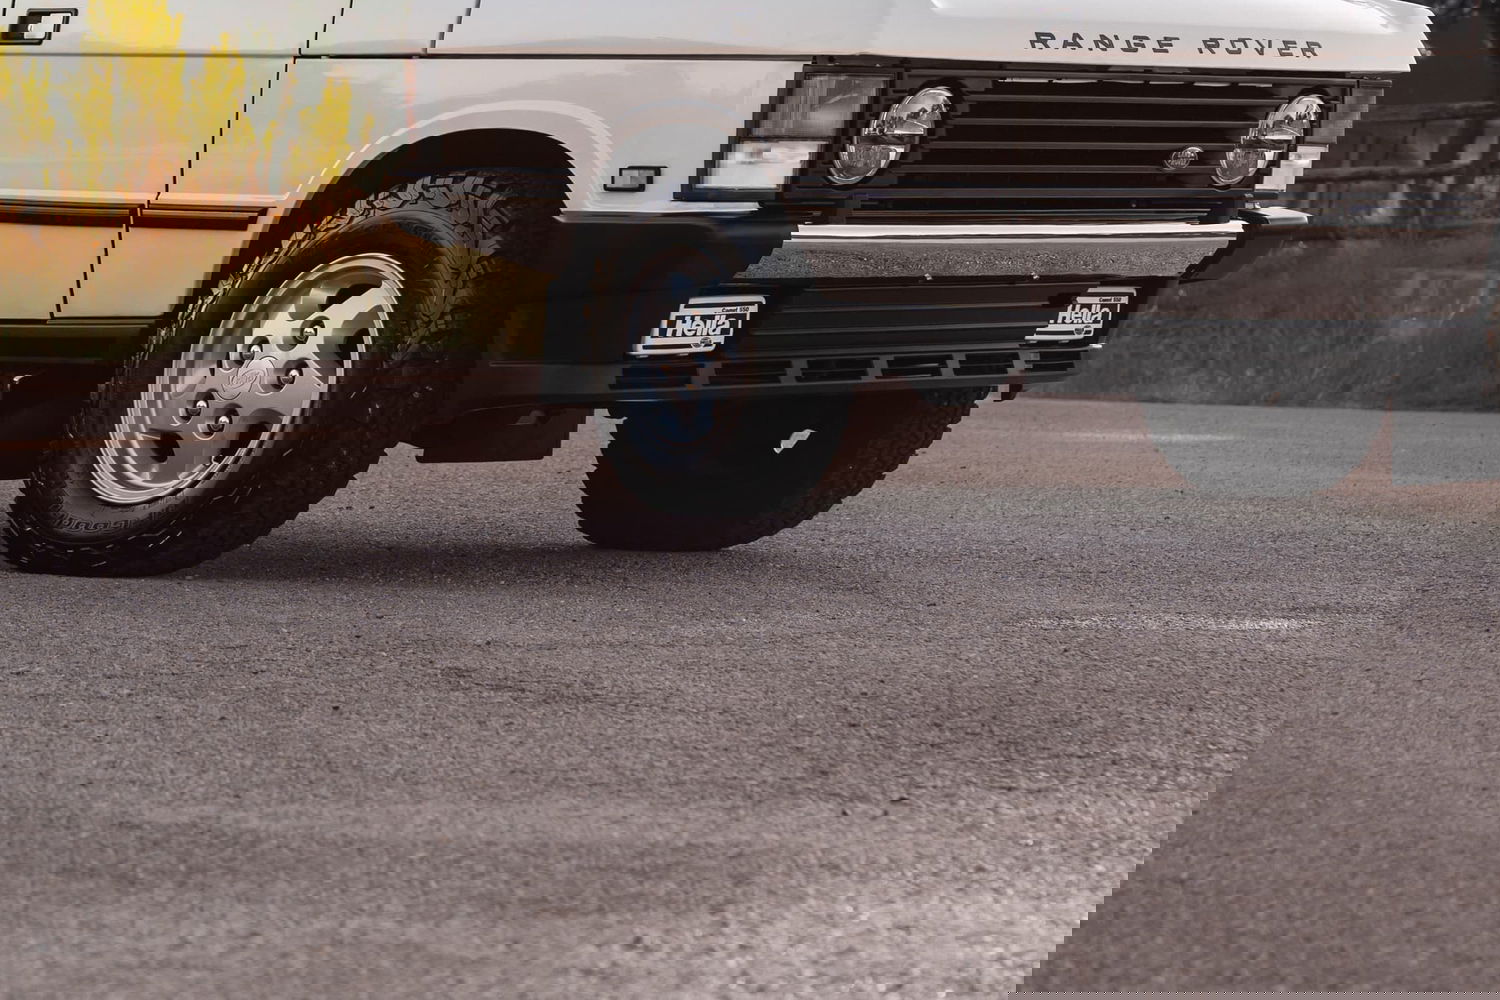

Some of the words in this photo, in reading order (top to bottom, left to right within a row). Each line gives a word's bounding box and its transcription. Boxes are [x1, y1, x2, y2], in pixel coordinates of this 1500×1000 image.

[1029, 32, 1180, 53] RANGE
[1197, 38, 1322, 58] ROVER
[1050, 304, 1110, 323] Hella
[666, 314, 736, 337] Hella
